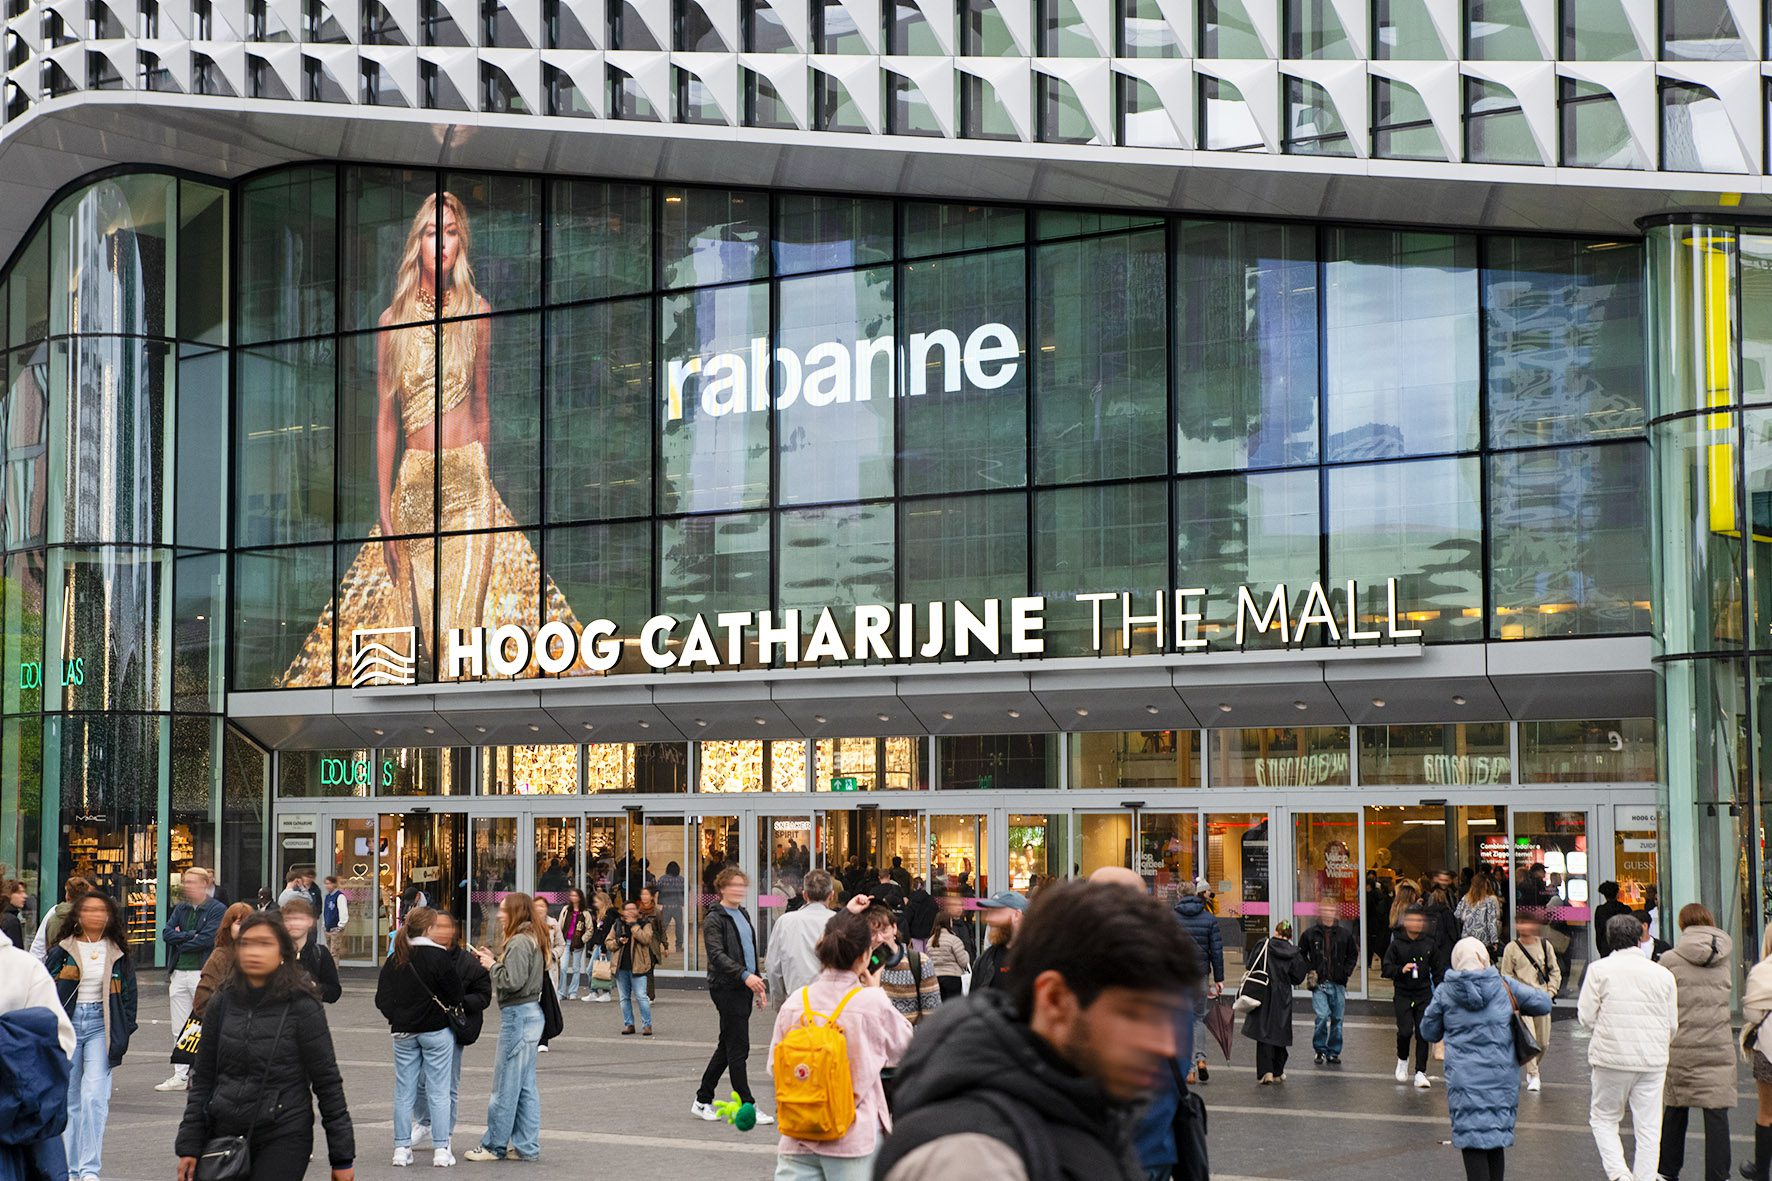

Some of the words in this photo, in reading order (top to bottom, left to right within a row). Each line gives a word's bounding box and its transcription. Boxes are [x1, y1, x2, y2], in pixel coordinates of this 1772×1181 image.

[667, 322, 1020, 421] rabanne
[449, 618, 623, 678] HOOG
[639, 596, 1046, 669] CATHARIJNE
[1075, 587, 1210, 651] THE
[1235, 577, 1423, 645] MALL
[321, 758, 393, 787] DOUGLS
[774, 831, 799, 839] SPIRIT
